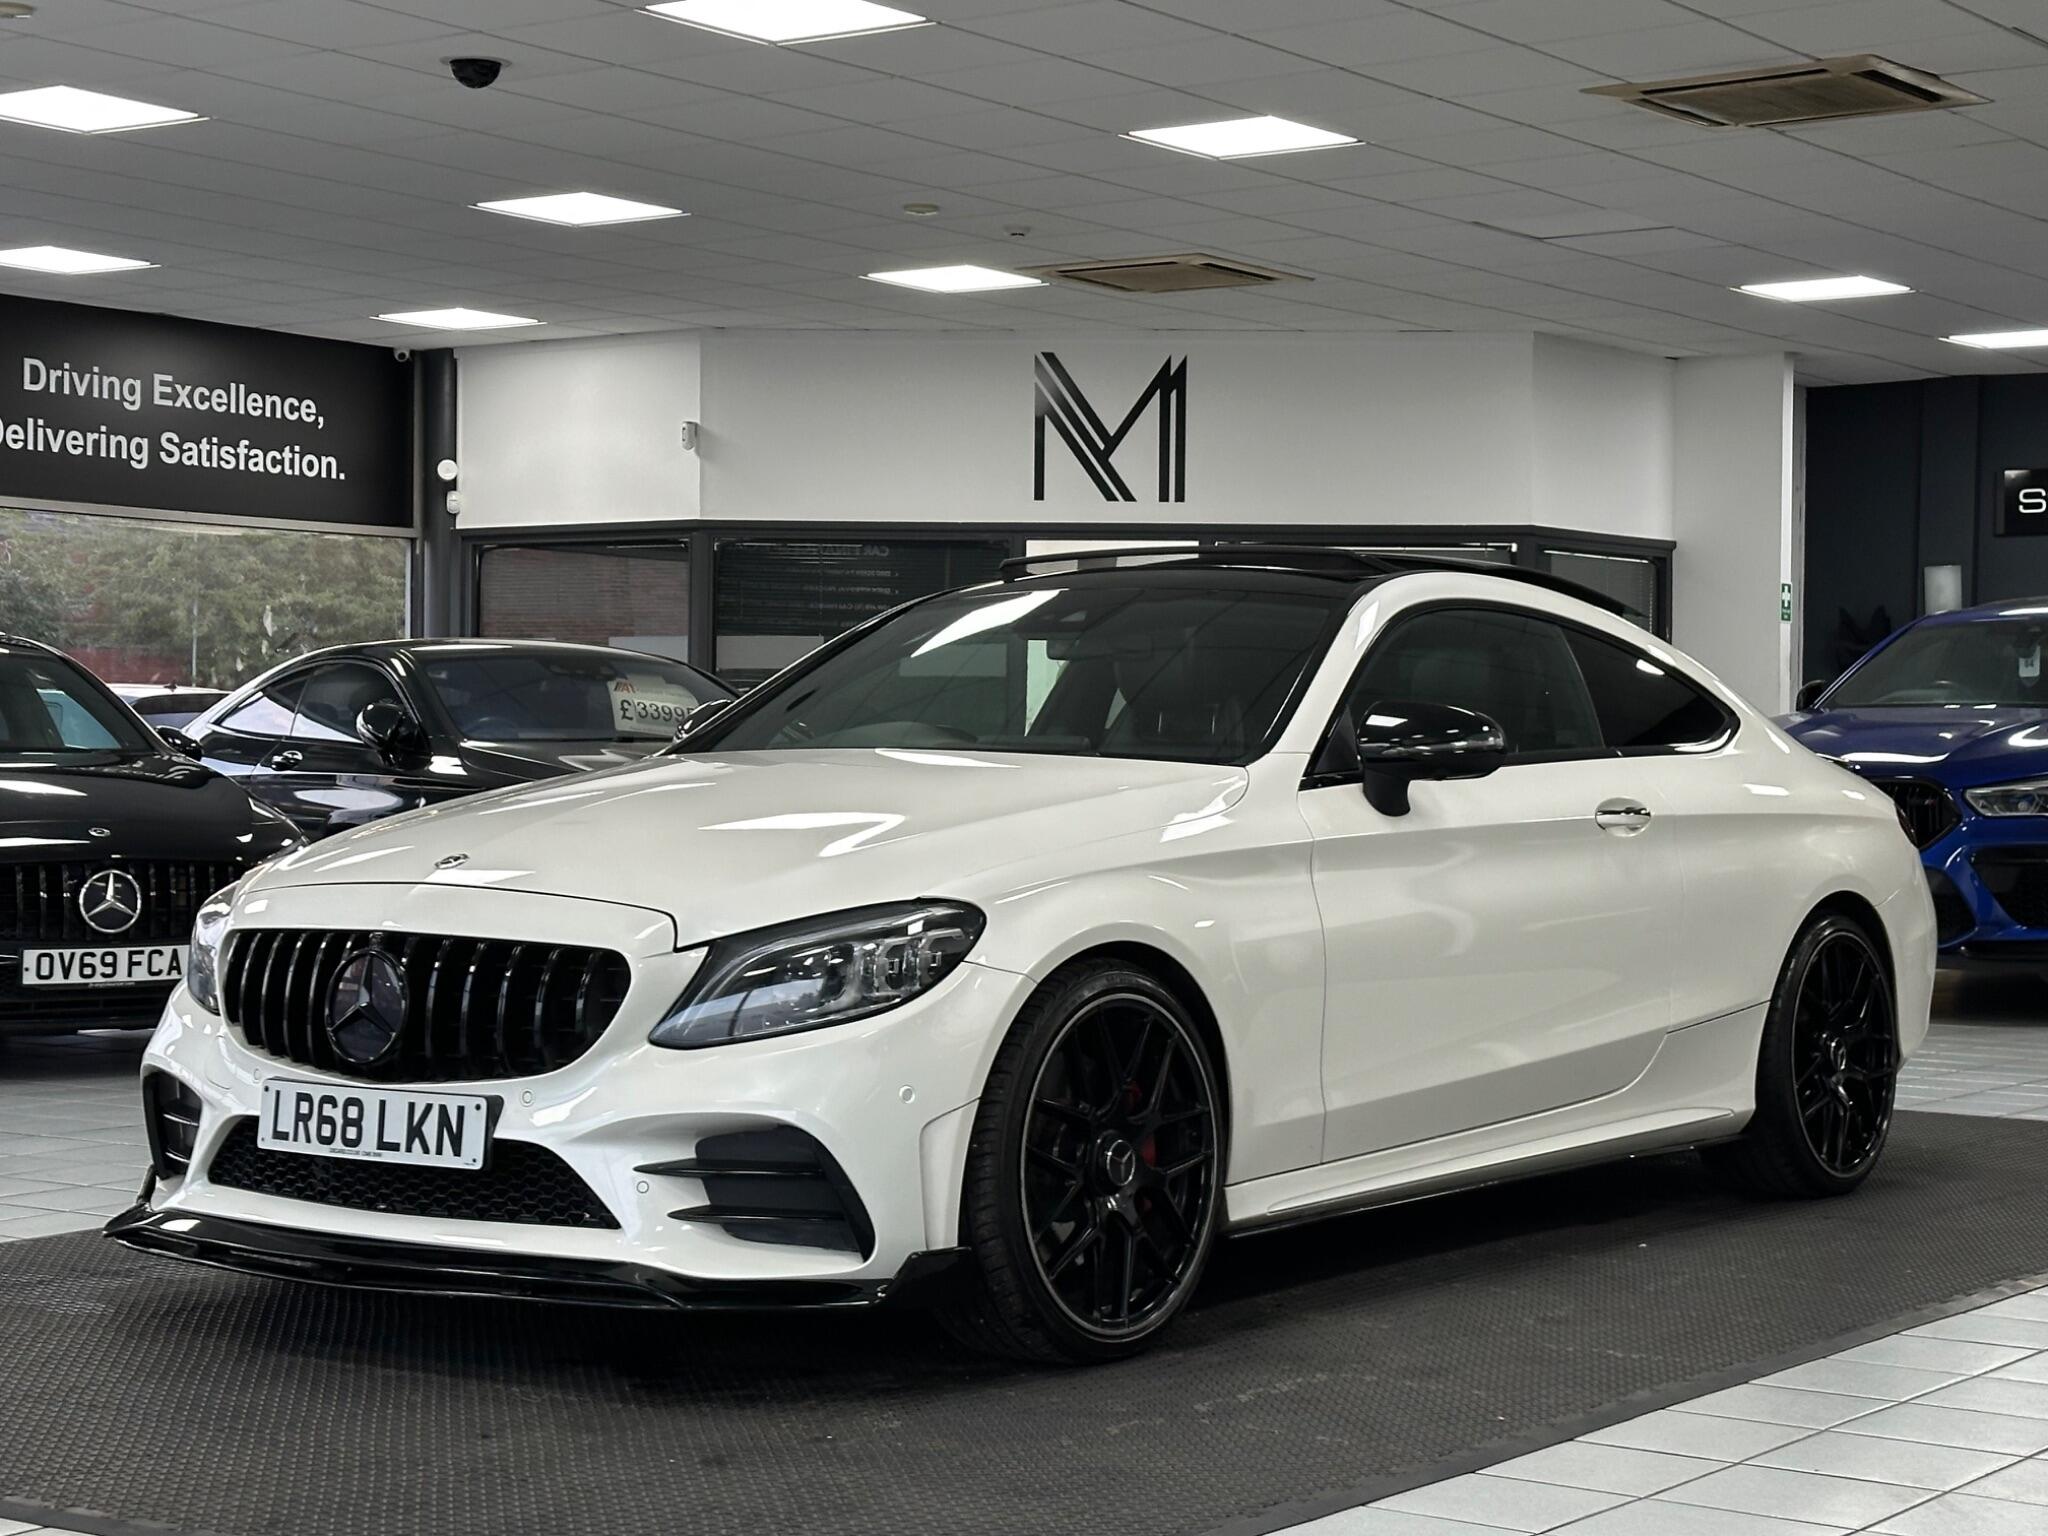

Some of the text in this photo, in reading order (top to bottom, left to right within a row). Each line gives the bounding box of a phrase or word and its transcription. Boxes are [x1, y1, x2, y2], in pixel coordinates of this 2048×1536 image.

[23, 357, 325, 430] Driving Excellence,
[159, 431, 346, 480] Satisfaction.
[2018, 488, 2047, 514] S
[35, 948, 182, 980] OV69 FCA
[271, 1090, 466, 1158] LR68 LKN
